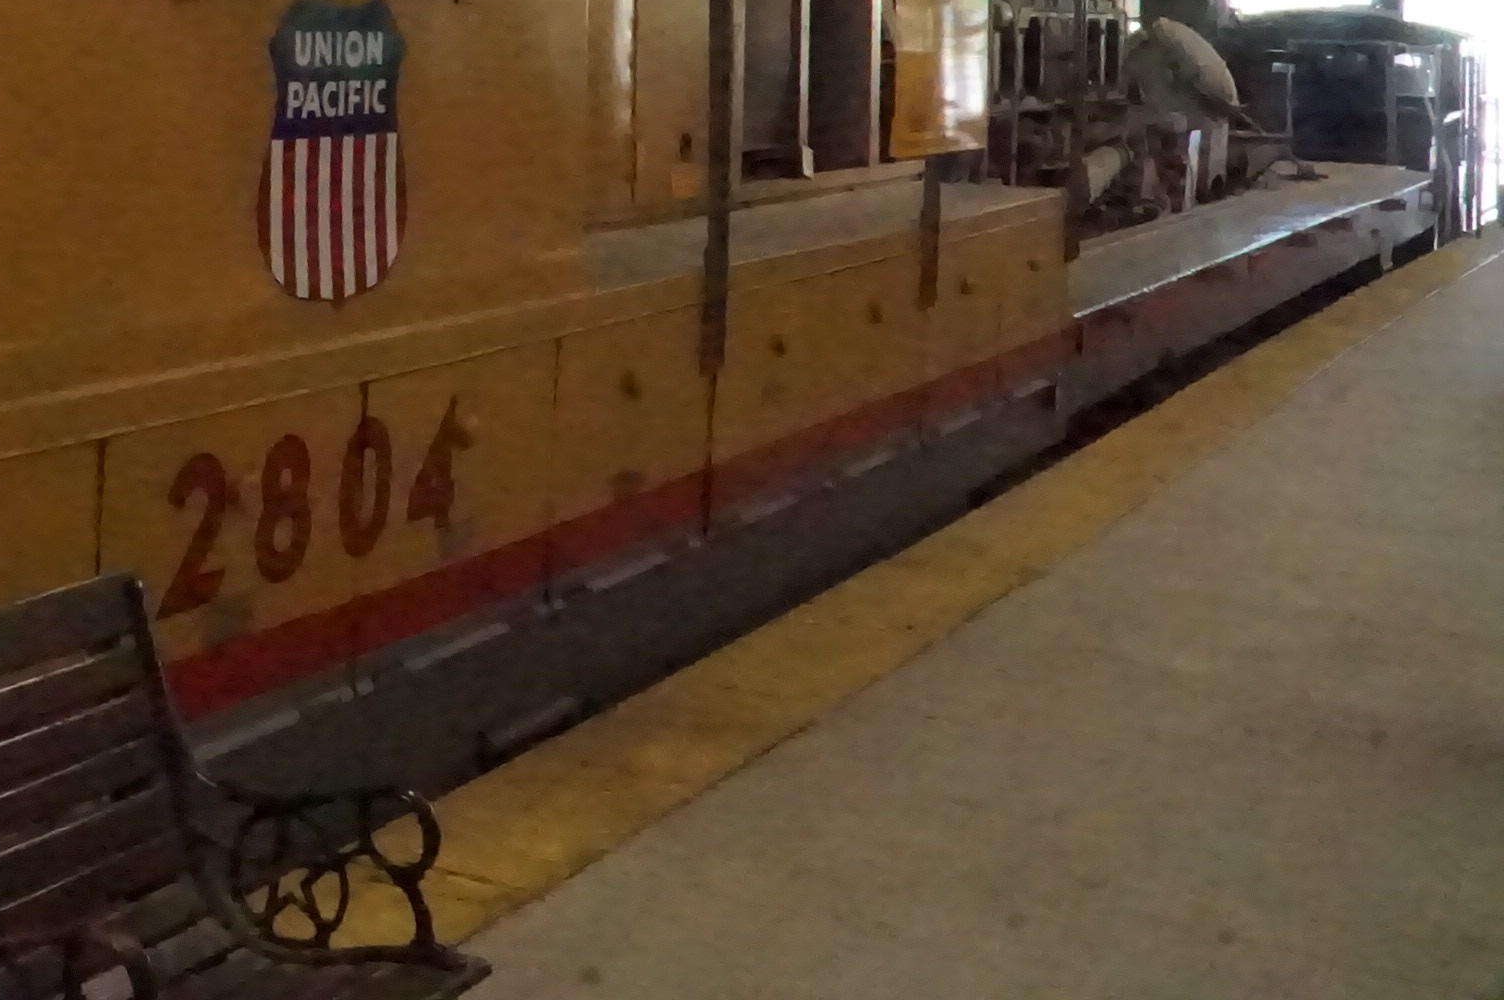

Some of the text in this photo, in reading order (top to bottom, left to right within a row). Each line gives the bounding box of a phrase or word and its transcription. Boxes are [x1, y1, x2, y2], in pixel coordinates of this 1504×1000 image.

[294, 30, 384, 68] UNION
[286, 78, 387, 120] PACIFIC
[155, 394, 471, 622] 2804
